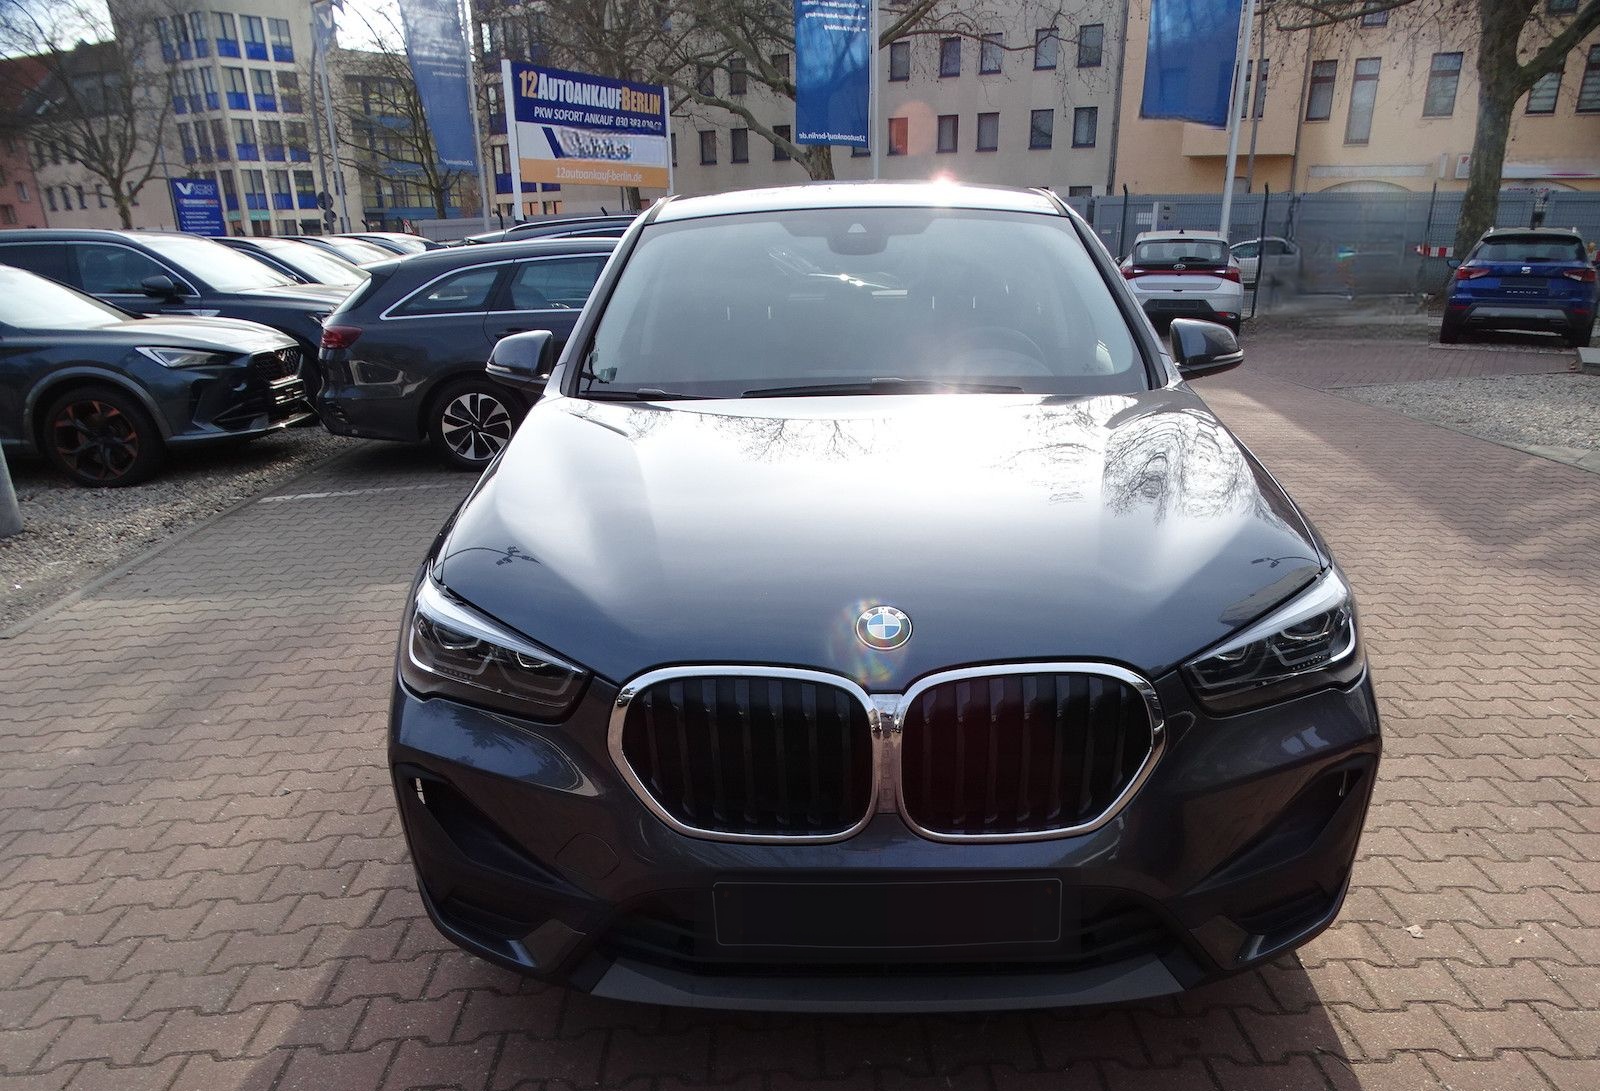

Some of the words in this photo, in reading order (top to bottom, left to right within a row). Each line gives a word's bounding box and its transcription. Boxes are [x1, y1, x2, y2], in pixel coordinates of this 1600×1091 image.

[534, 106, 553, 118] PKW
[554, 108, 583, 122] SOFORT
[585, 112, 613, 126] ANKAUF
[861, 607, 906, 620] BMW
